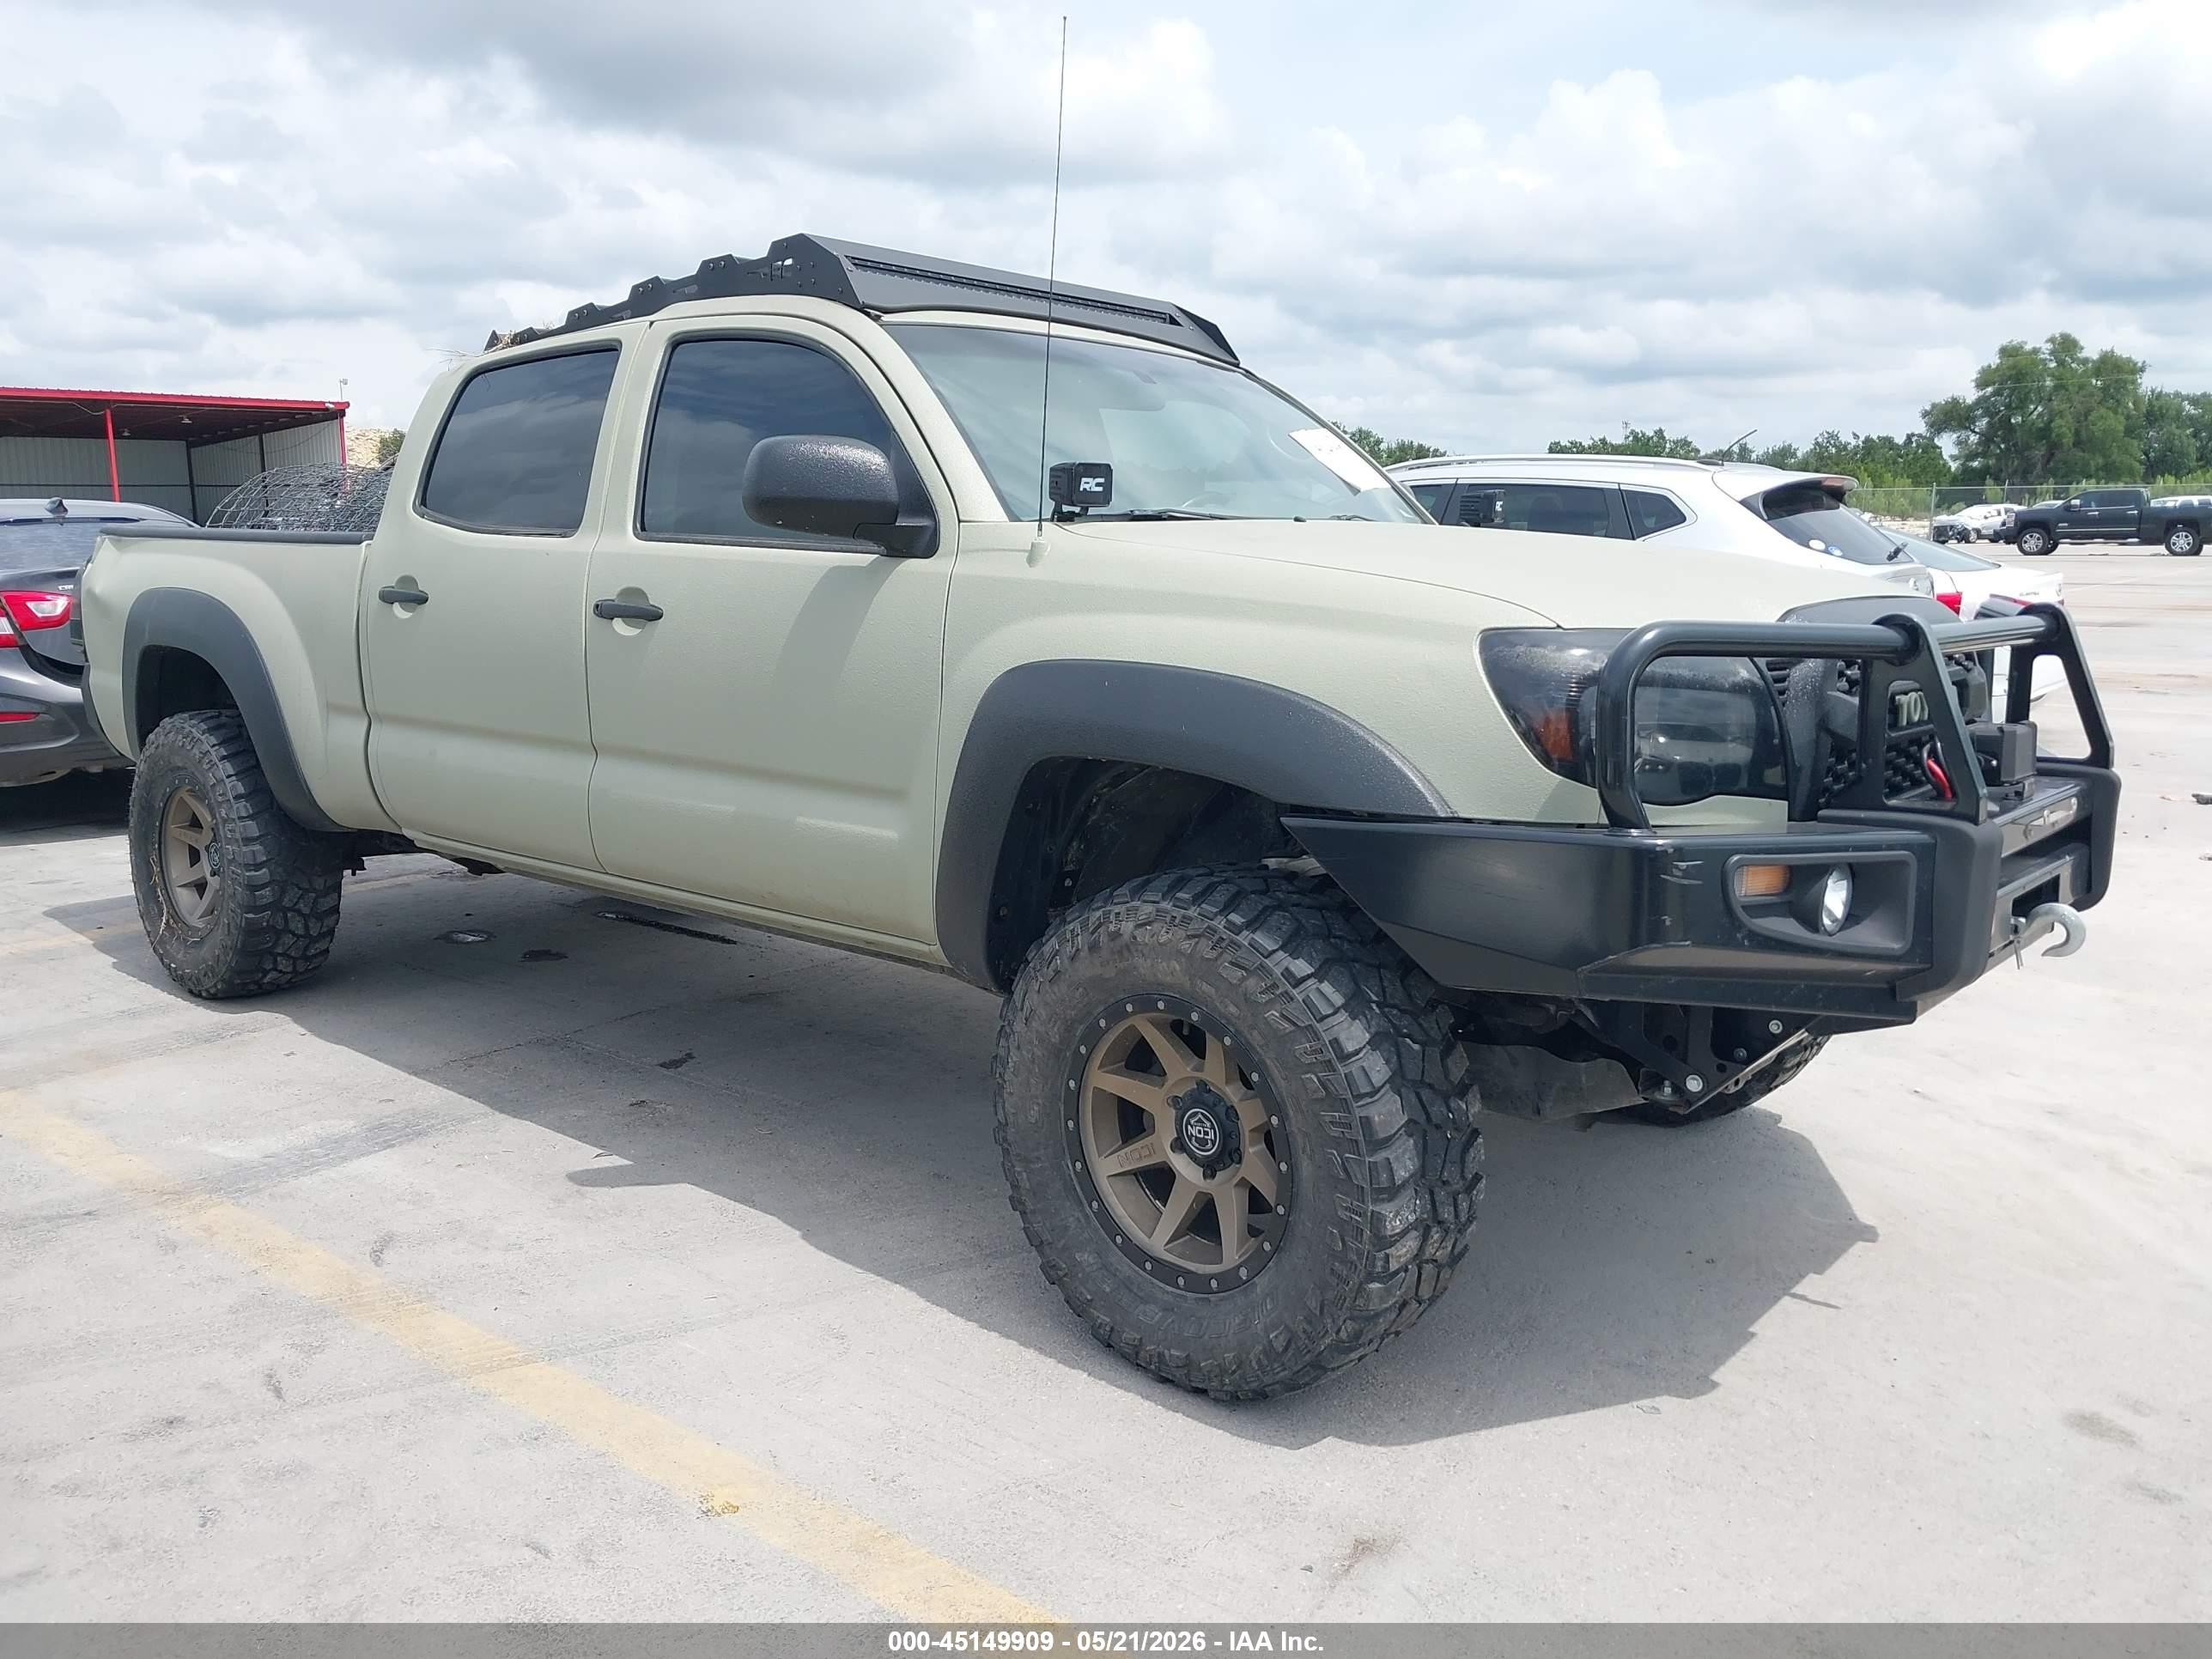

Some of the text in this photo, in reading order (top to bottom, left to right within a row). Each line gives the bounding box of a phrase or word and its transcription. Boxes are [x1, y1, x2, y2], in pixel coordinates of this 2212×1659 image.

[1079, 477, 1105, 491] RC
[1188, 1124, 1215, 1142] ICON
[1116, 1143, 1156, 1169] ICON
